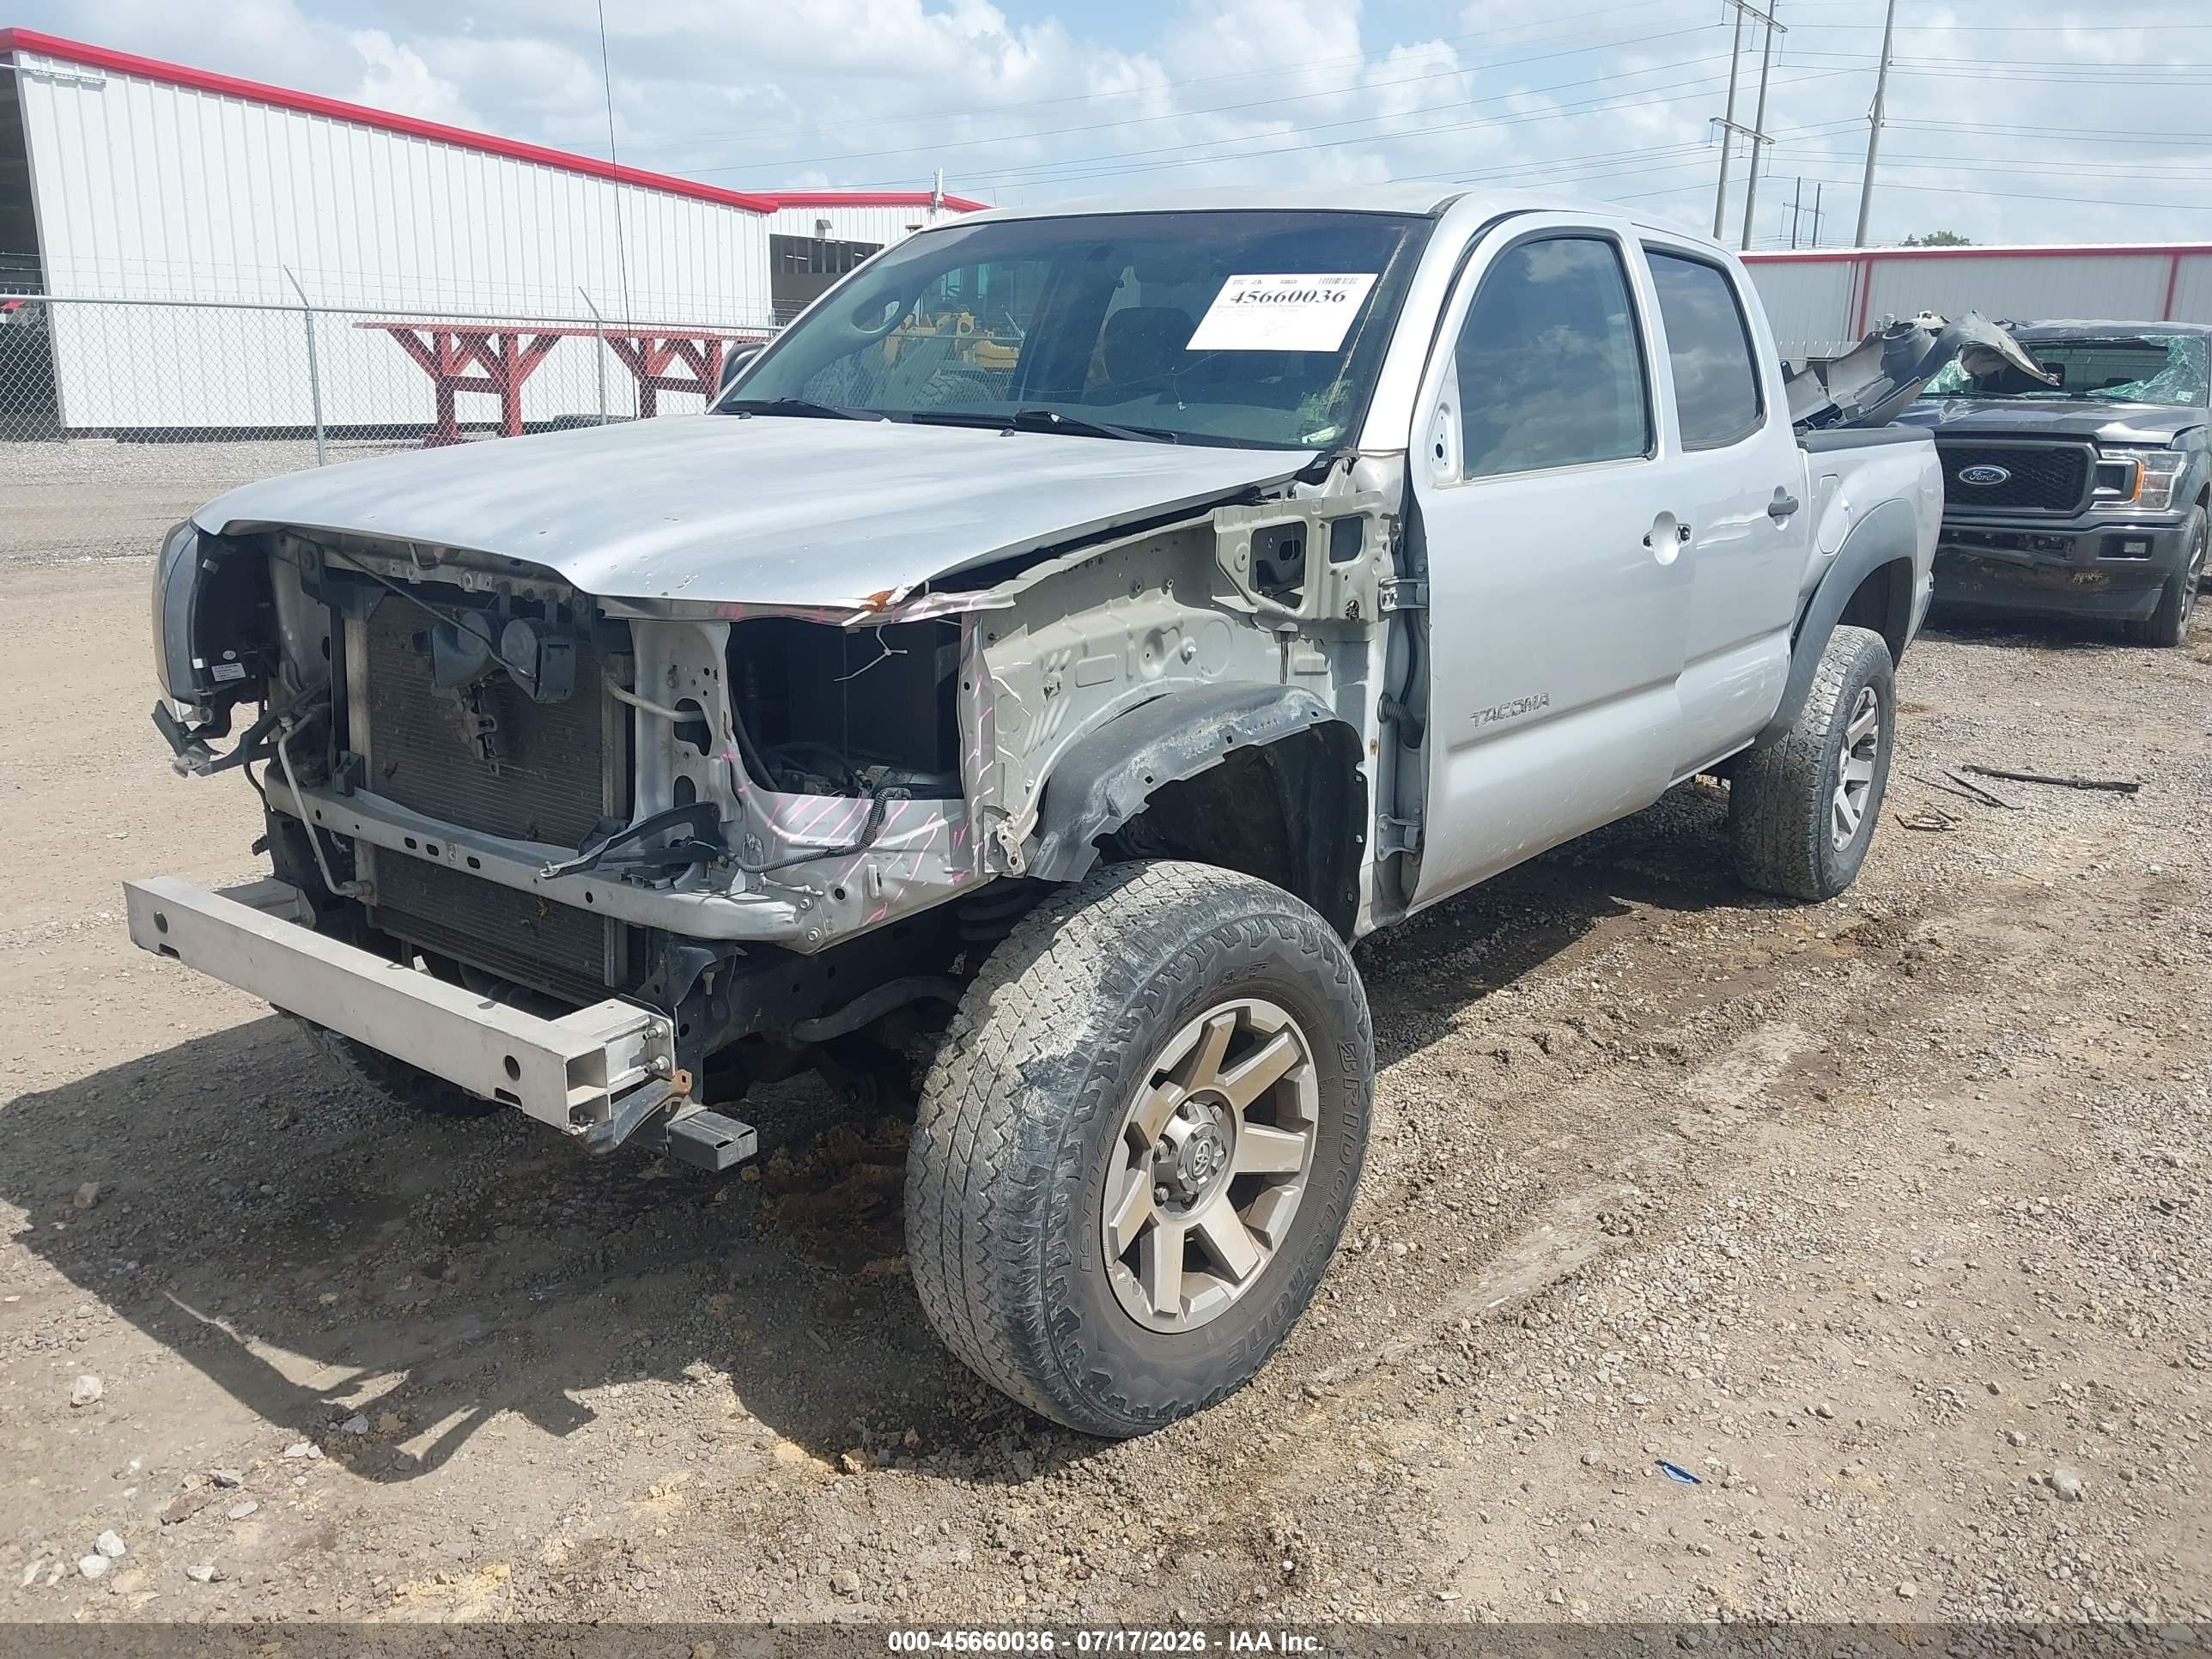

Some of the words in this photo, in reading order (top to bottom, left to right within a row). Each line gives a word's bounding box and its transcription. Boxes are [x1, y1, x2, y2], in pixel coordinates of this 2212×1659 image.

[1230, 289, 1348, 304] 45660036
[1969, 470, 1996, 481] Ford
[1469, 692, 1551, 728] TACOMA
[1225, 1041, 1361, 1370] BRIDGESTONE
